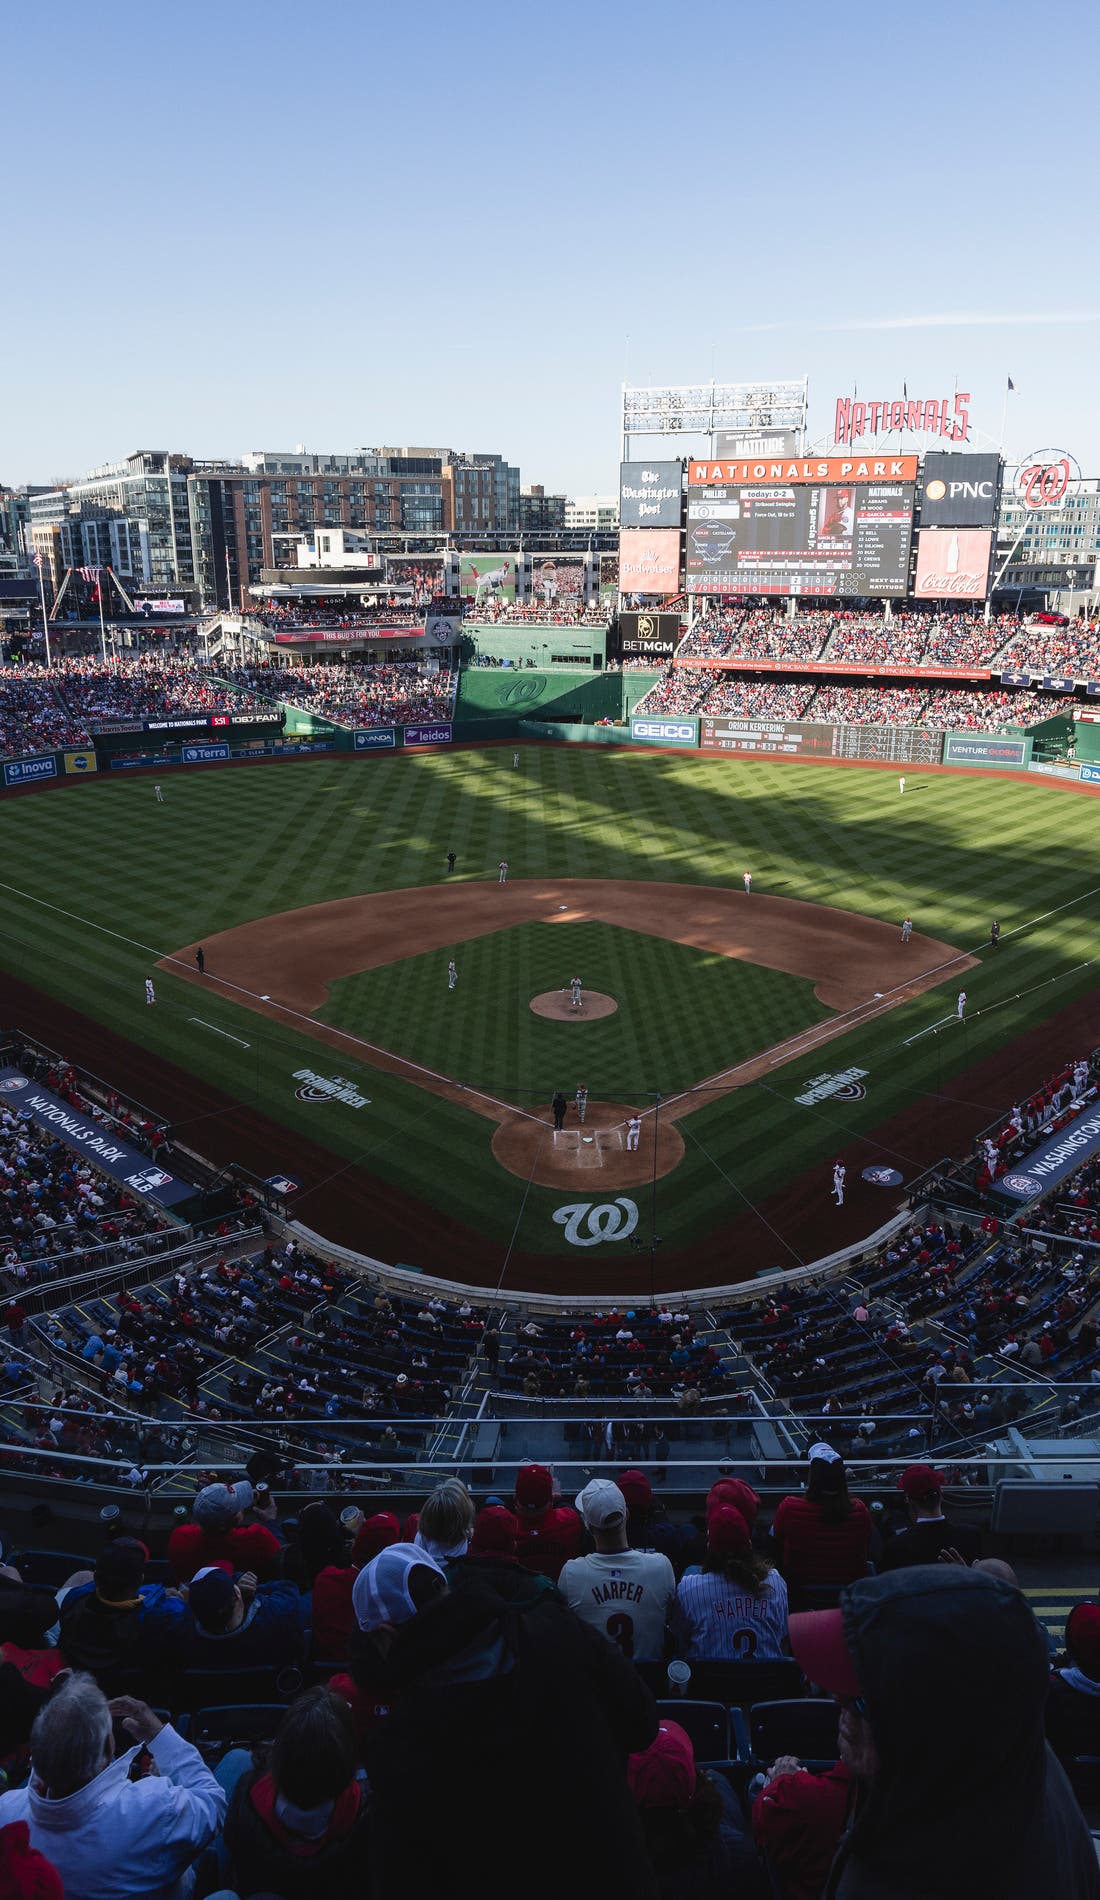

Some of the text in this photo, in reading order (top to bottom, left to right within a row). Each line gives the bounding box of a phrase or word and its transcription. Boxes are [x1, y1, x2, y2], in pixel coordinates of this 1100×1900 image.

[834, 393, 970, 444] NATIONALS
[736, 436, 784, 456] NATITUDE
[641, 470, 660, 484] The
[696, 462, 904, 479] NATIONALS PARK
[622, 485, 680, 500] Washington
[748, 490, 772, 498] today:
[868, 488, 903, 496] NATIONALS
[949, 480, 993, 499] PNC
[638, 502, 662, 518] Post
[622, 563, 674, 574] Budweiser
[918, 568, 984, 594] Coca-Cola
[623, 640, 673, 652] BETMGM
[634, 723, 693, 739] GEICO
[728, 722, 785, 733] ORION KERKERING
[419, 730, 450, 742] leidos
[199, 748, 226, 759] Terra
[952, 746, 988, 755] VENTURE
[22, 761, 52, 774] Inova
[292, 1069, 372, 1108] OPENING WEEK
[24, 1095, 128, 1163] NATIONALS PARK
[124, 1174, 154, 1194] MLB
[592, 1580, 644, 1605] HARPER
[714, 1599, 768, 1618] HARPER
